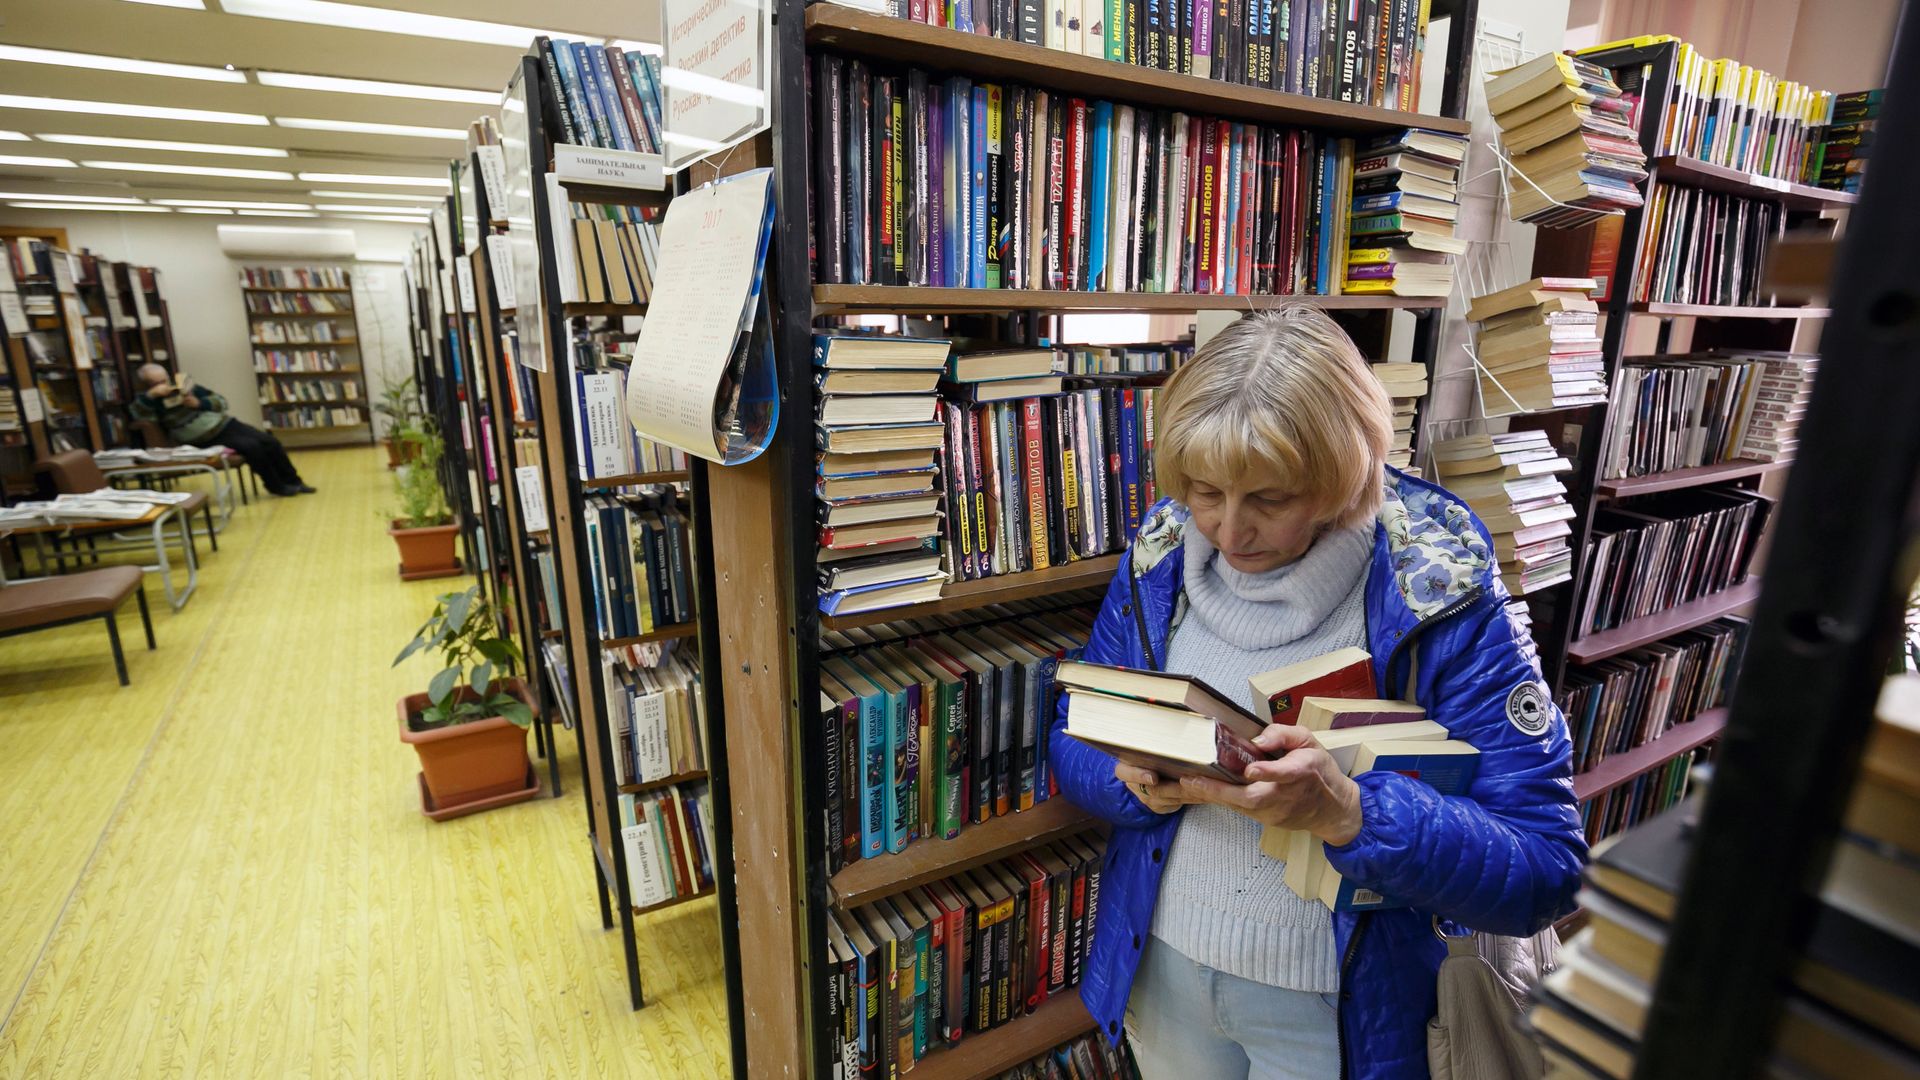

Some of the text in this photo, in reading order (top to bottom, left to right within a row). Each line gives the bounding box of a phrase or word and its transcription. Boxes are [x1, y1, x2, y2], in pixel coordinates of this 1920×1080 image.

[711, 15, 746, 60] детектив
[1342, 30, 1356, 101] В. ШИТОВ
[1014, 132, 1023, 173] УДАР
[1074, 106, 1084, 170] ПРОХОРОВКОЙ
[576, 157, 646, 170] ЗАНИМАТЕЛЬНАЯ
[597, 169, 625, 177] НАУКА
[702, 208, 724, 230] 2017
[976, 195, 984, 242] МАЛЫШЕВА
[1050, 137, 1063, 269] СИРЕНЕВЫЙ ТУМАН
[1072, 188, 1081, 233] ШТРАФБАТ
[1201, 165, 1213, 270] Николай ЛЕОНОВ
[988, 217, 999, 260] Рандеву
[1028, 439, 1041, 487] ШИТОВ
[1098, 458, 1107, 499] МОНАХ
[1012, 480, 1021, 522] КОЛЫЧЕВ
[1129, 483, 1138, 518] ЮРСКАЯ
[1031, 492, 1046, 565] ВЛАДИМИР
[947, 704, 956, 732] Сергей
[826, 717, 836, 797] СТЕПАНОВА
[637, 840, 651, 884] Геометрия
[1052, 929, 1066, 984] АЛМАЗЫ
[1072, 919, 1082, 984] ПАУТИНА
[829, 975, 837, 1015] КАФЕДРА
